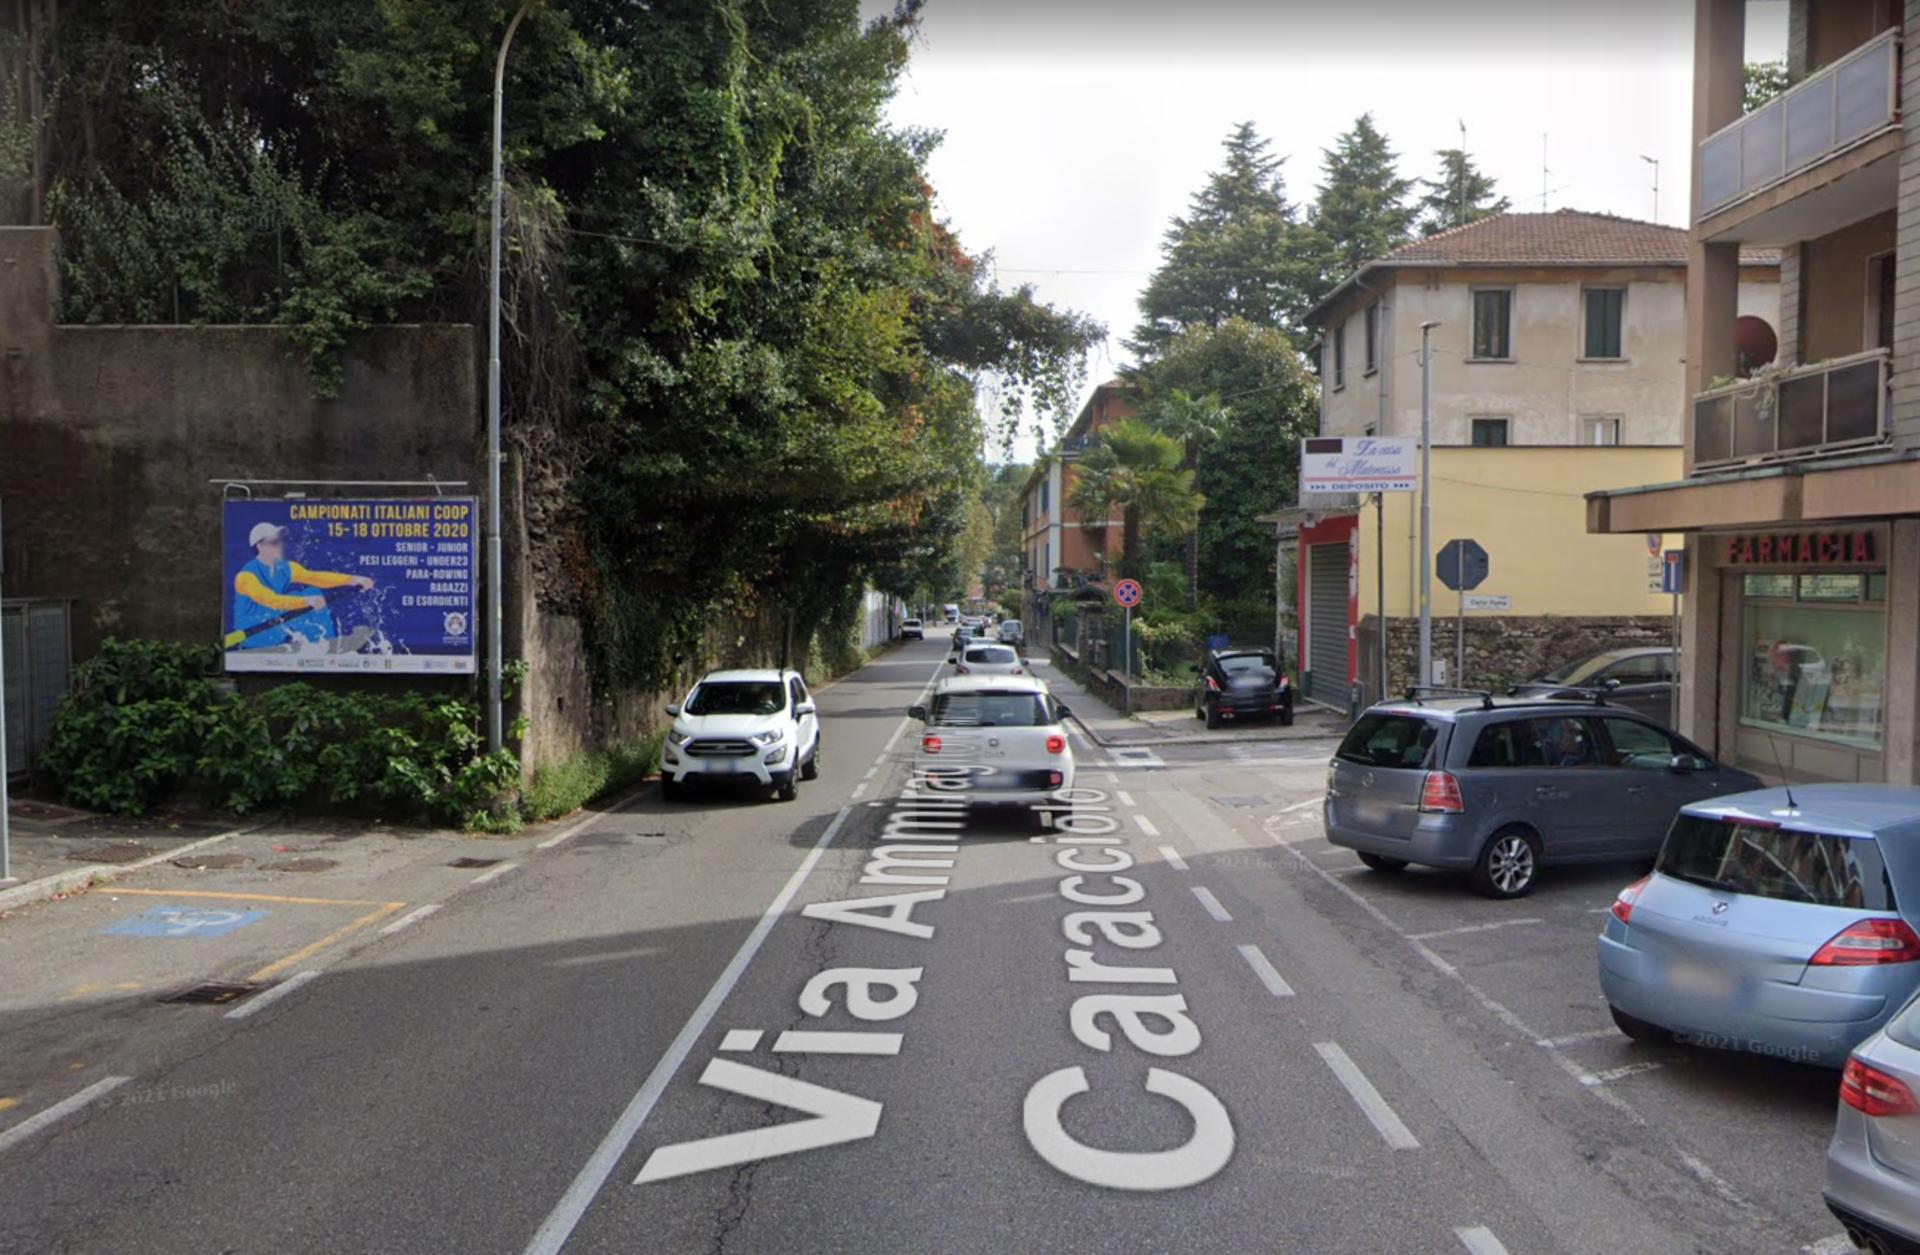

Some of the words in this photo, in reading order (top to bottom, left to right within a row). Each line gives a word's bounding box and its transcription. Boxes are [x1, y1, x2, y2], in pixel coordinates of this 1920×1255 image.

[1331, 482, 1390, 490] DEPOSITO
[289, 504, 371, 520] CAMPIONATI
[374, 504, 430, 520] ITALIANI
[434, 504, 469, 520] COOP
[353, 522, 368, 538] 18
[371, 522, 430, 538] OTTOBRE
[433, 522, 469, 538] 2020
[395, 542, 428, 552] SENIOR
[436, 542, 468, 552] JUNIOR
[1728, 532, 1868, 563] FARMACIA
[359, 555, 380, 566] PESI
[381, 555, 418, 566] LEGGERI
[426, 555, 468, 566] UNDER23
[405, 569, 468, 579] PARA-ROWING
[430, 583, 468, 593] RAGAZZI
[402, 596, 415, 606] ED
[416, 596, 468, 606] ESORDIENTI
